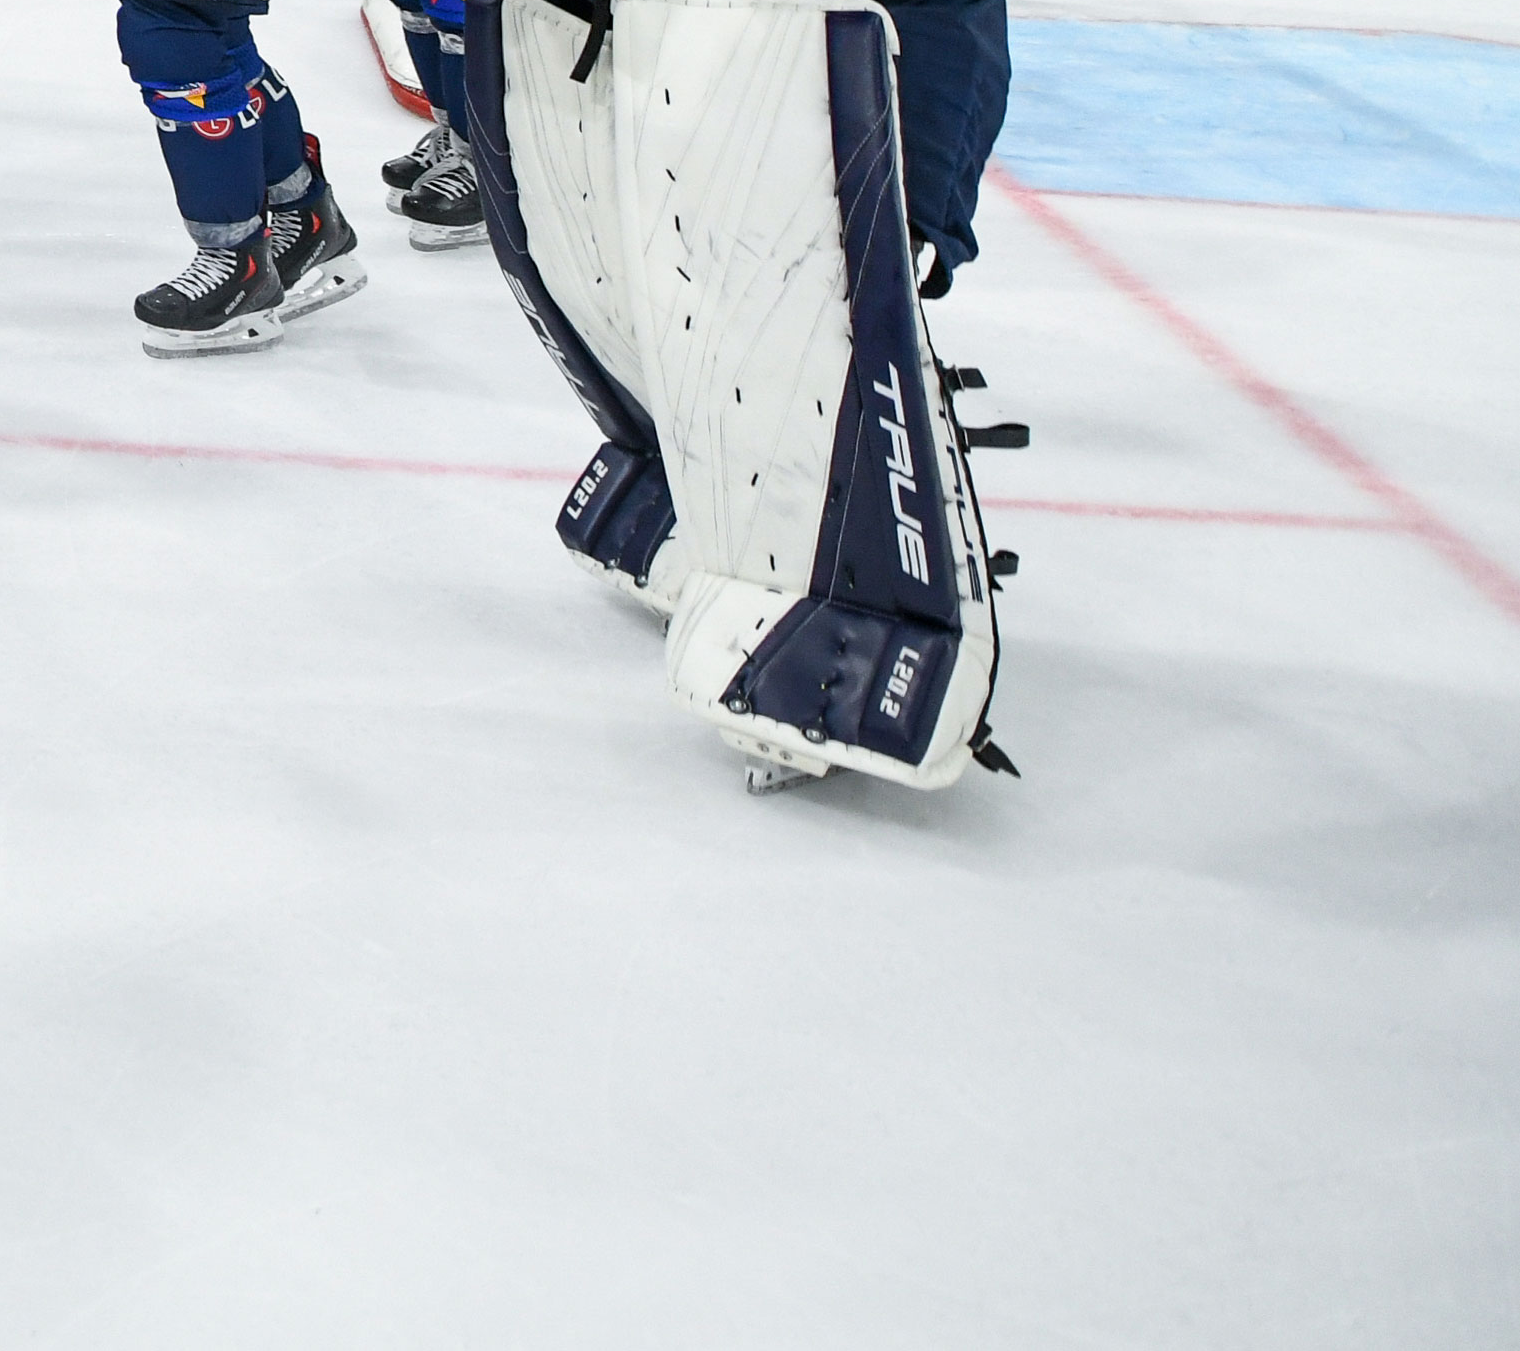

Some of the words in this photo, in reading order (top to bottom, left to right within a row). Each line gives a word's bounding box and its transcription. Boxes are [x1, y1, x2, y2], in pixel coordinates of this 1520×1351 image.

[502, 269, 602, 427] TRUE
[871, 360, 932, 588] TRUE
[878, 645, 922, 722] L20.2
